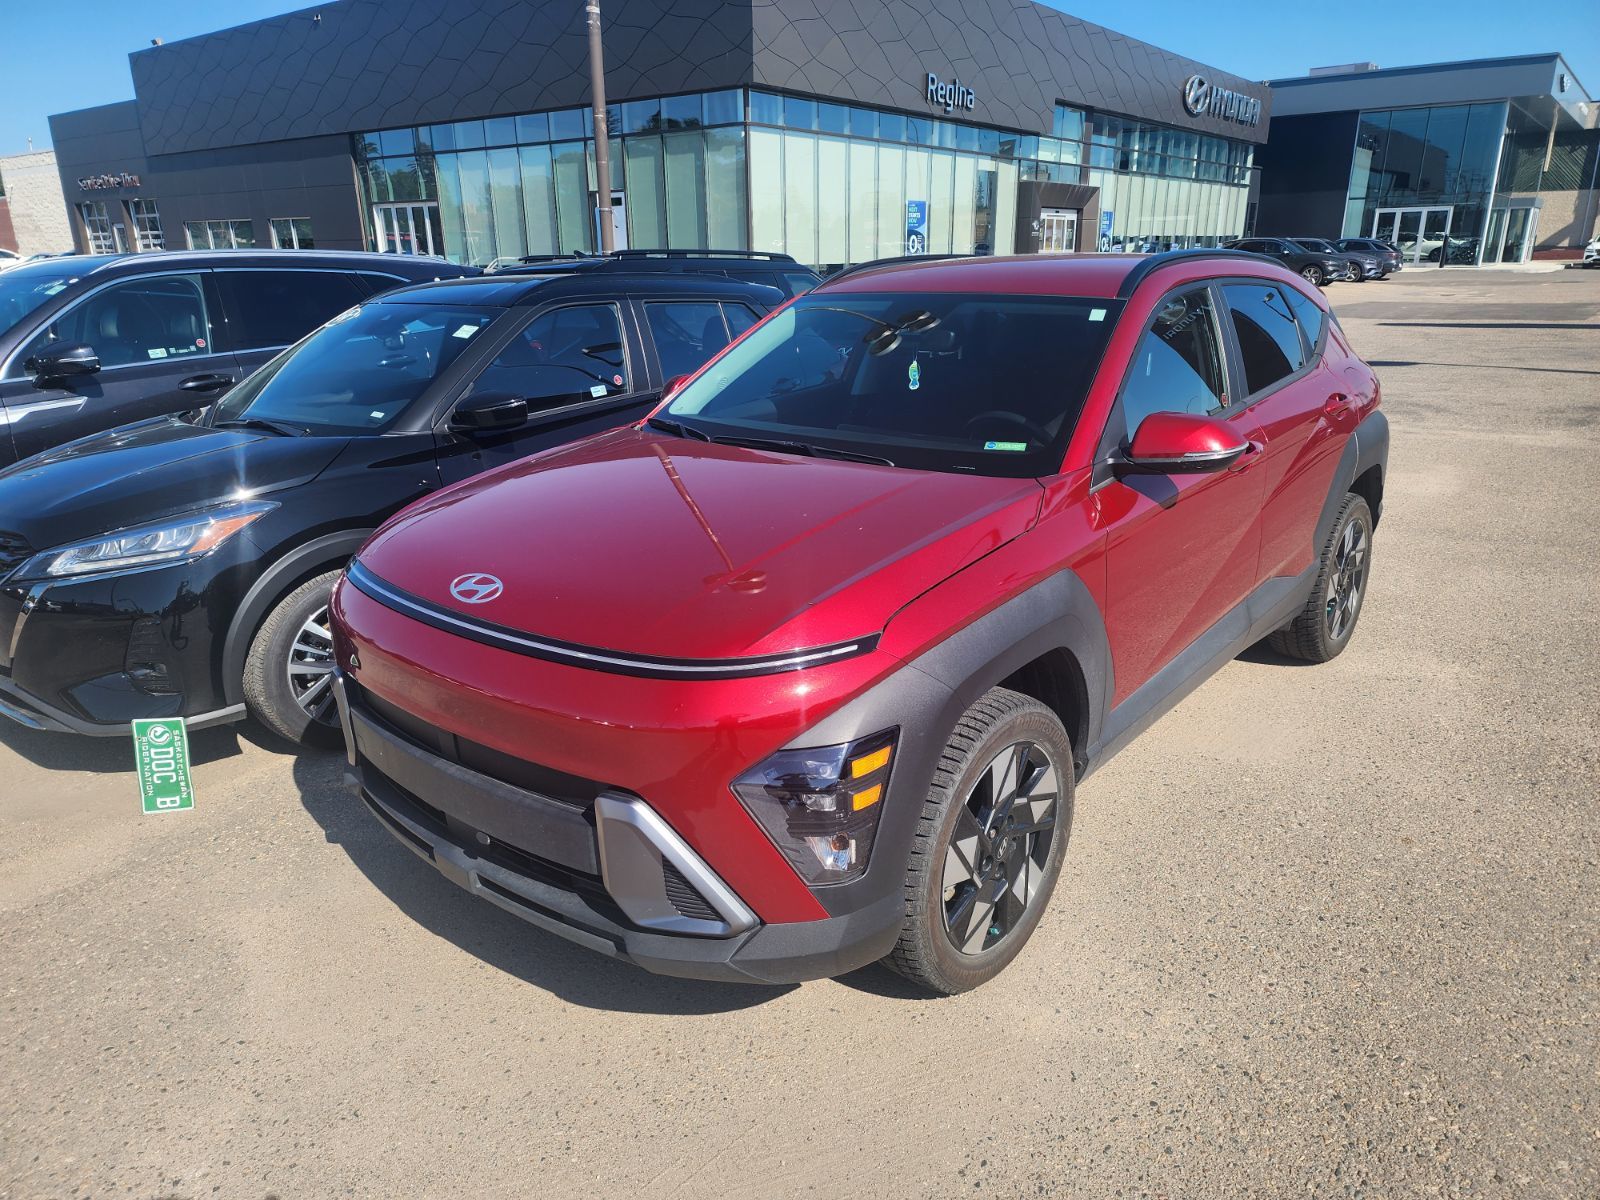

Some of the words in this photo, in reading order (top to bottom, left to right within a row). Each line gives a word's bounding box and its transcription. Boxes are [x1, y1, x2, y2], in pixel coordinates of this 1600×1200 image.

[927, 72, 975, 111] Regina
[141, 736, 150, 763] RIDER
[150, 746, 177, 784] DOC
[173, 729, 189, 799] SASKATCHEWAN
[144, 765, 154, 797] NATION
